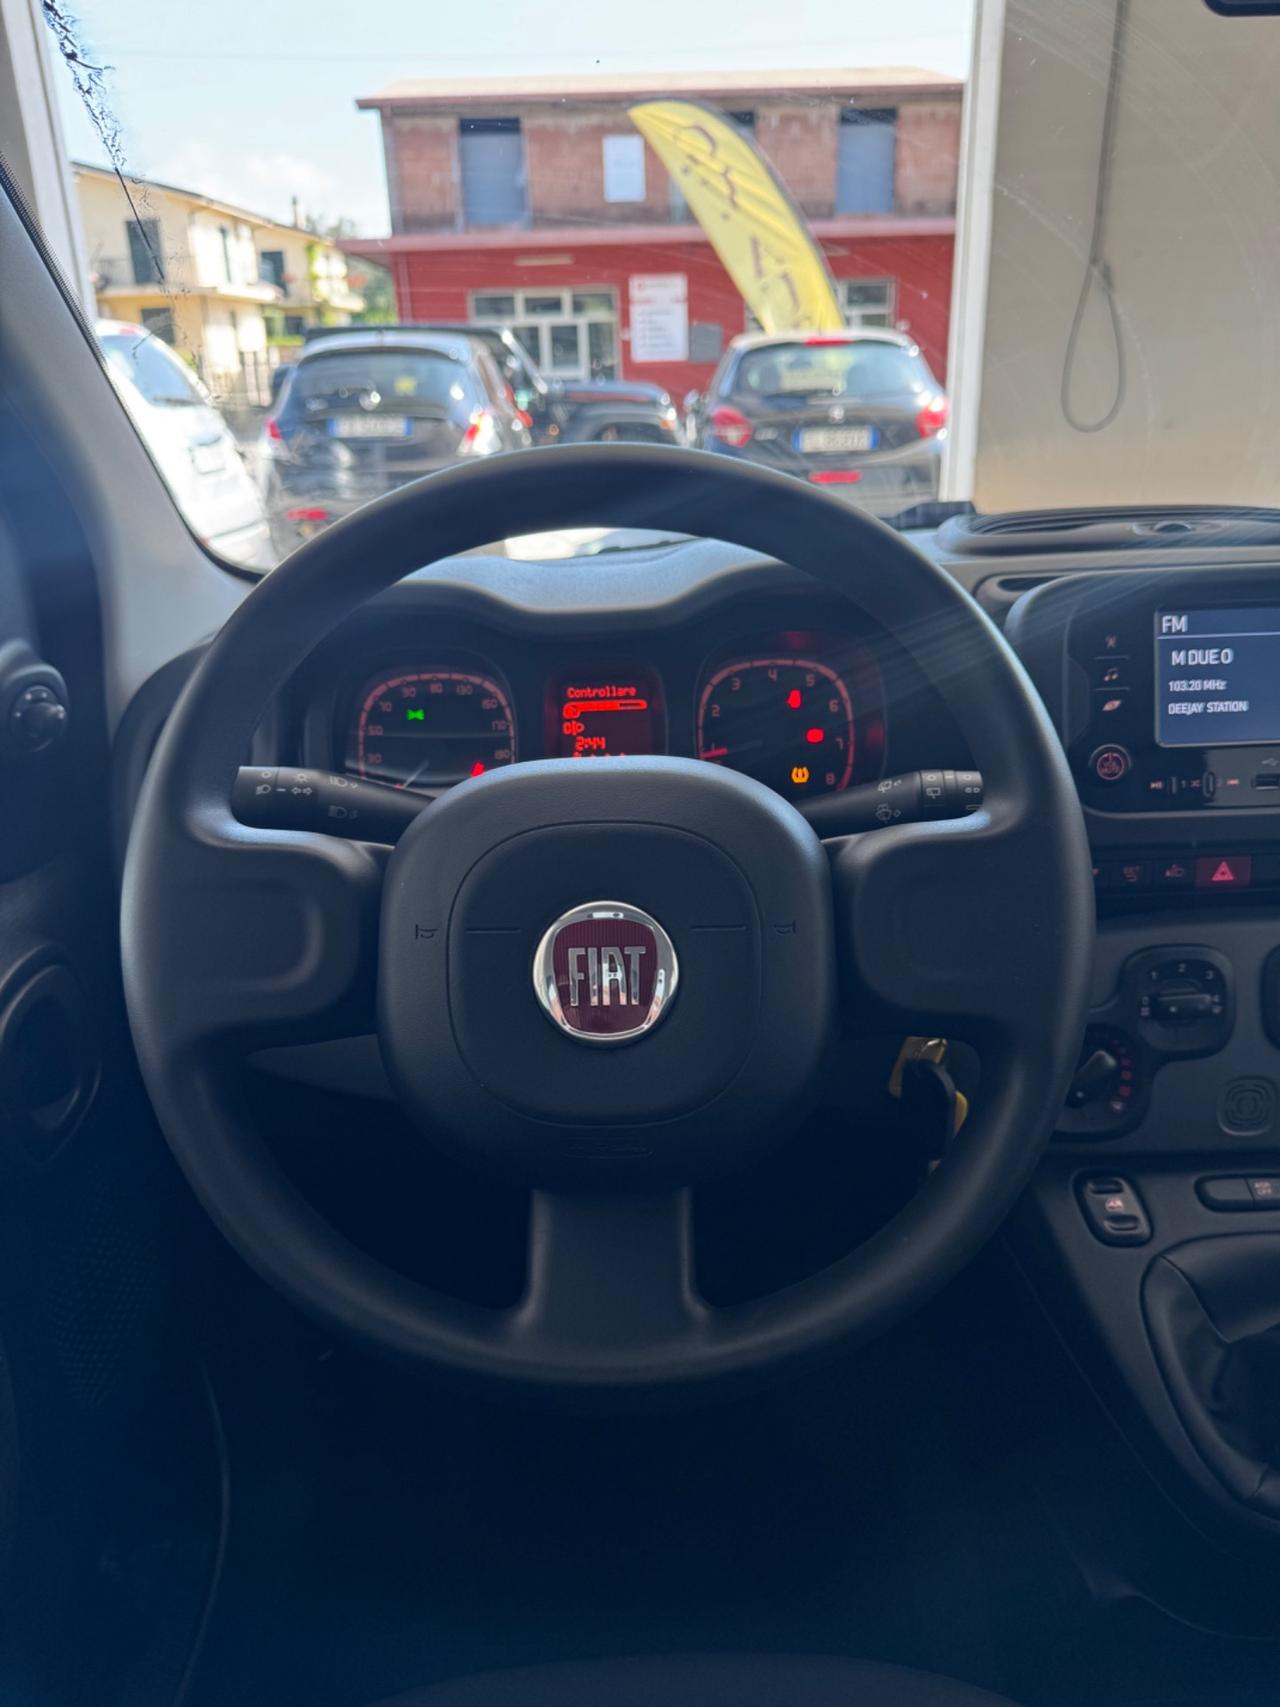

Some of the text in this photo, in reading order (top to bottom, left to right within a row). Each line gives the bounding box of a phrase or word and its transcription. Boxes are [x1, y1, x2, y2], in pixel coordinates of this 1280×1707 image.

[1162, 615, 1188, 633] FM
[768, 670, 778, 682] 4
[806, 675, 816, 687] 5
[731, 678, 741, 691] 3
[1168, 679, 1227, 692] 103.20 MHz
[567, 686, 637, 698] Controllare
[379, 701, 393, 712] 70
[711, 705, 720, 717] 2
[829, 699, 839, 712] 6
[1168, 700, 1248, 716] DEEJAY STATION
[368, 725, 384, 736] 50
[575, 736, 606, 751] 2:44
[835, 738, 844, 750] 7
[825, 773, 835, 785] 8
[568, 946, 646, 1006] FIAT
